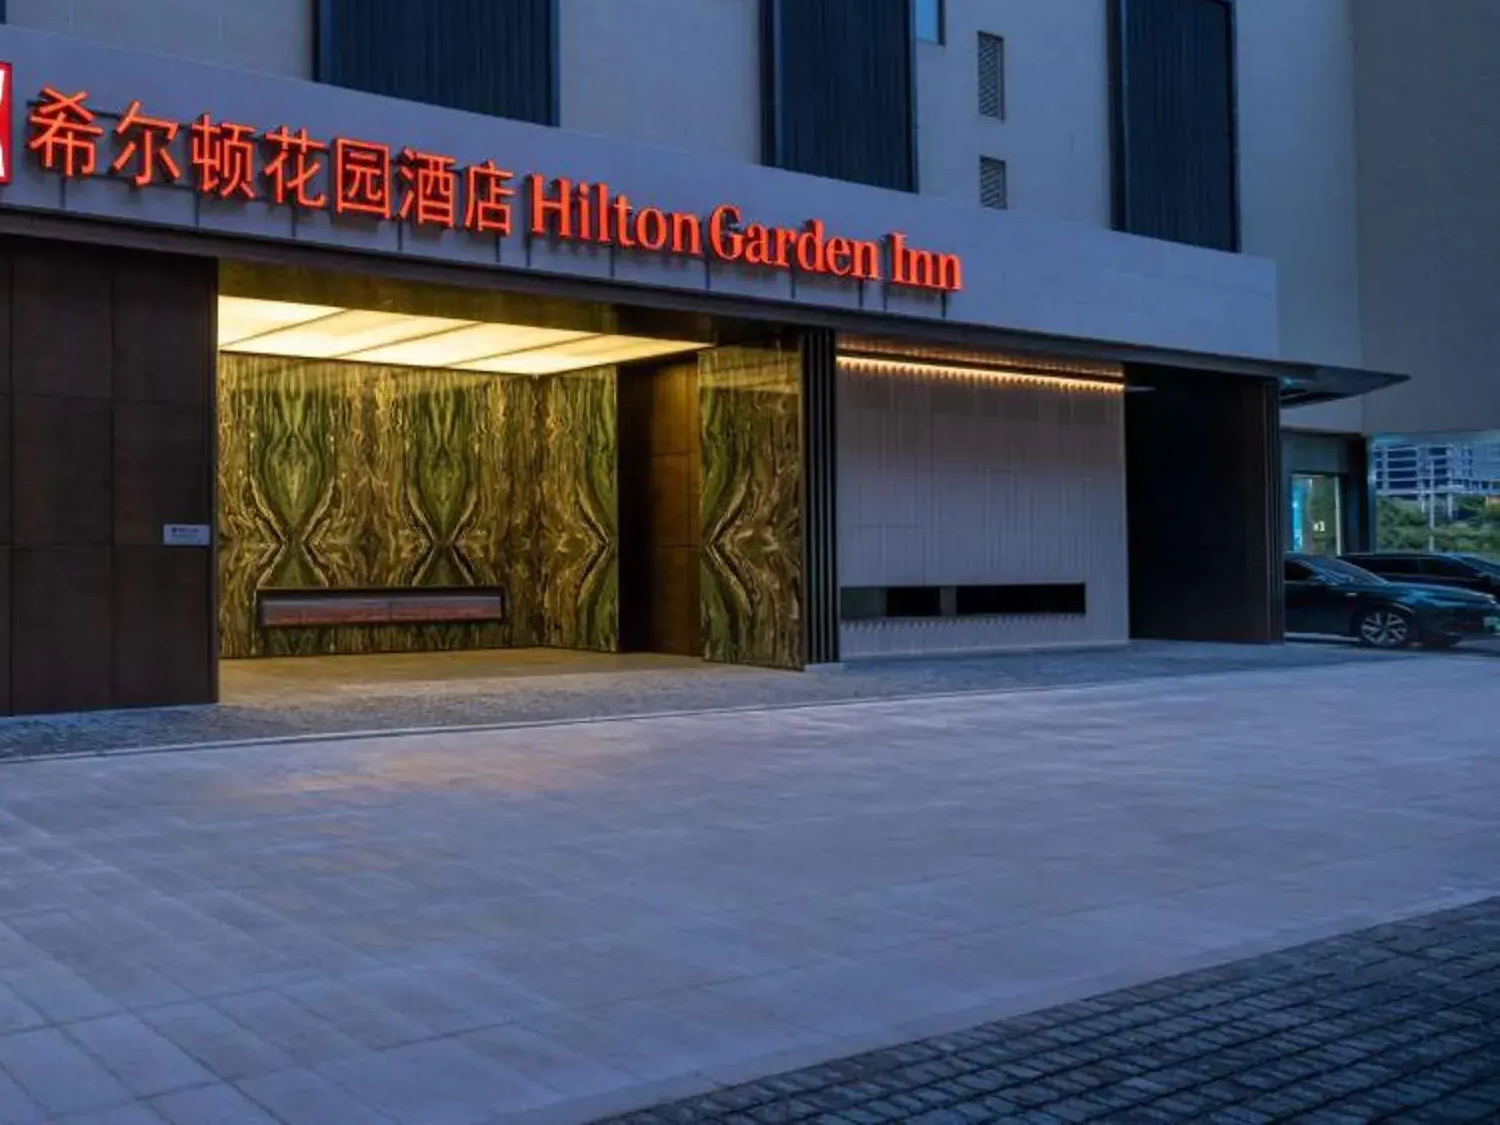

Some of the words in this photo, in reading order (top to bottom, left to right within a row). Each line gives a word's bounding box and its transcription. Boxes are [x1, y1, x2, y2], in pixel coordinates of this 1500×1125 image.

[28, 86, 516, 236] 希尔顿花园酒店
[529, 173, 702, 255] Hilton
[709, 204, 881, 280] Garden
[891, 232, 963, 291] Inn
